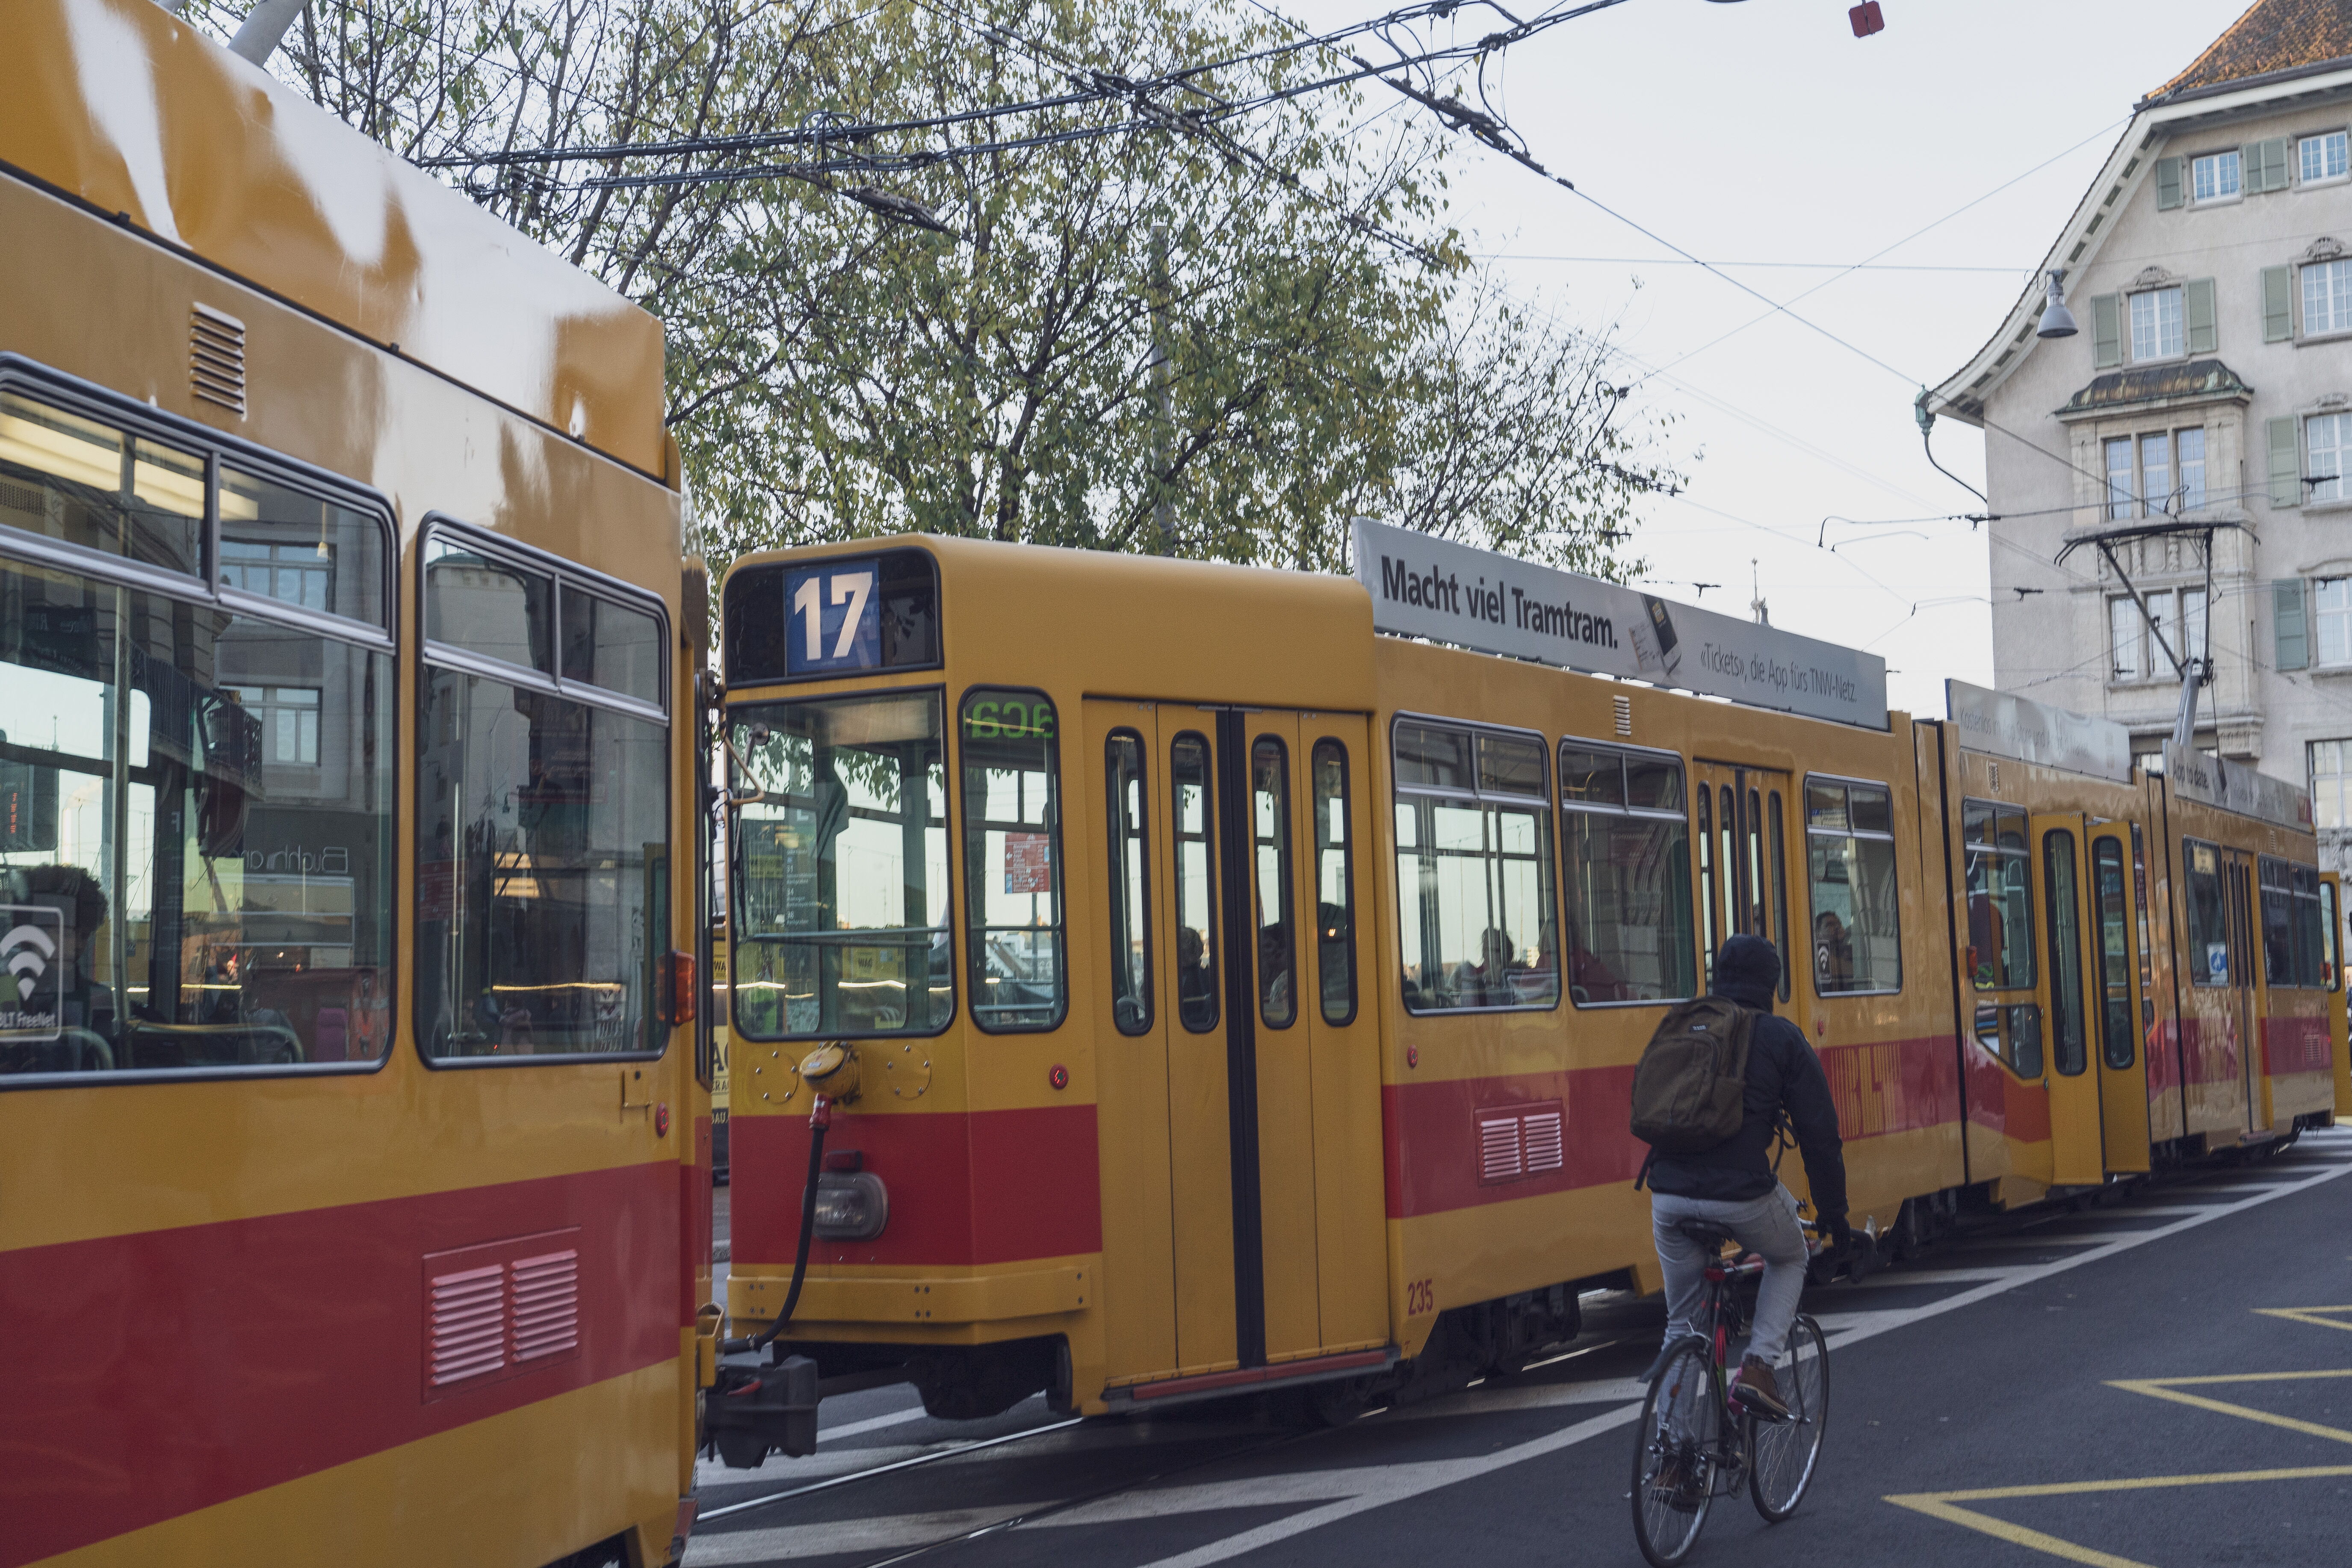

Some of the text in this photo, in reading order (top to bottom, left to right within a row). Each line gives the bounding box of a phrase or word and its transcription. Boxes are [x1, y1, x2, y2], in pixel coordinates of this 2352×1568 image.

[794, 571, 873, 661] 17
[1381, 555, 1619, 649] Macht viel Tramtram.
[1750, 654, 1766, 682] die
[1768, 659, 1788, 694] App
[1790, 661, 1808, 692] fürs
[1810, 668, 1858, 705] TNW-Netz.
[1407, 1278, 1433, 1316] 235
